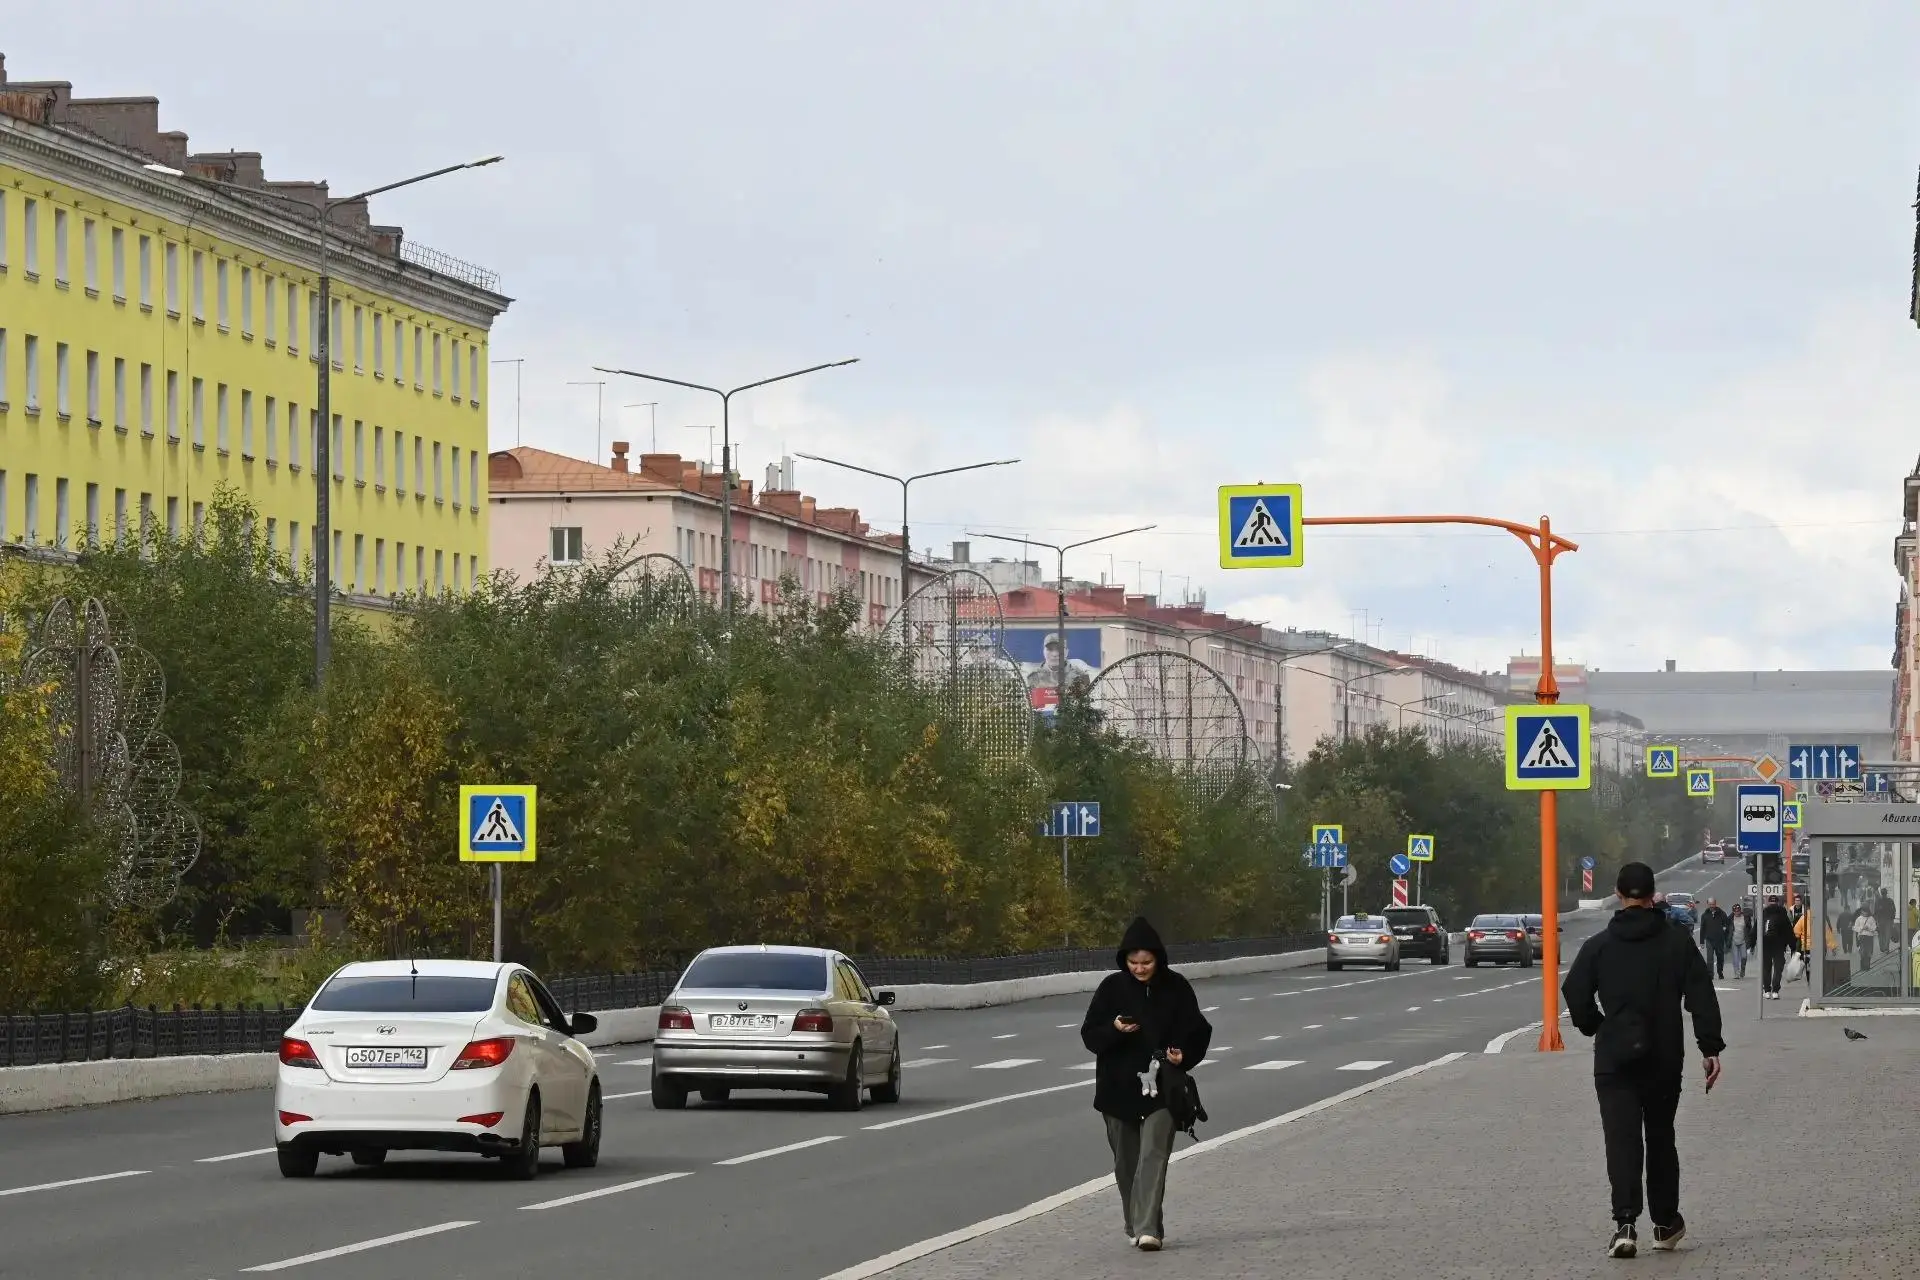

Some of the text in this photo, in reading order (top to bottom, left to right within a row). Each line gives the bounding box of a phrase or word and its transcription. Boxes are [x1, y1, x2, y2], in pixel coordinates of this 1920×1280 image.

[1751, 885, 1779, 894] СОП
[351, 1049, 423, 1063] О507ЕР 142
